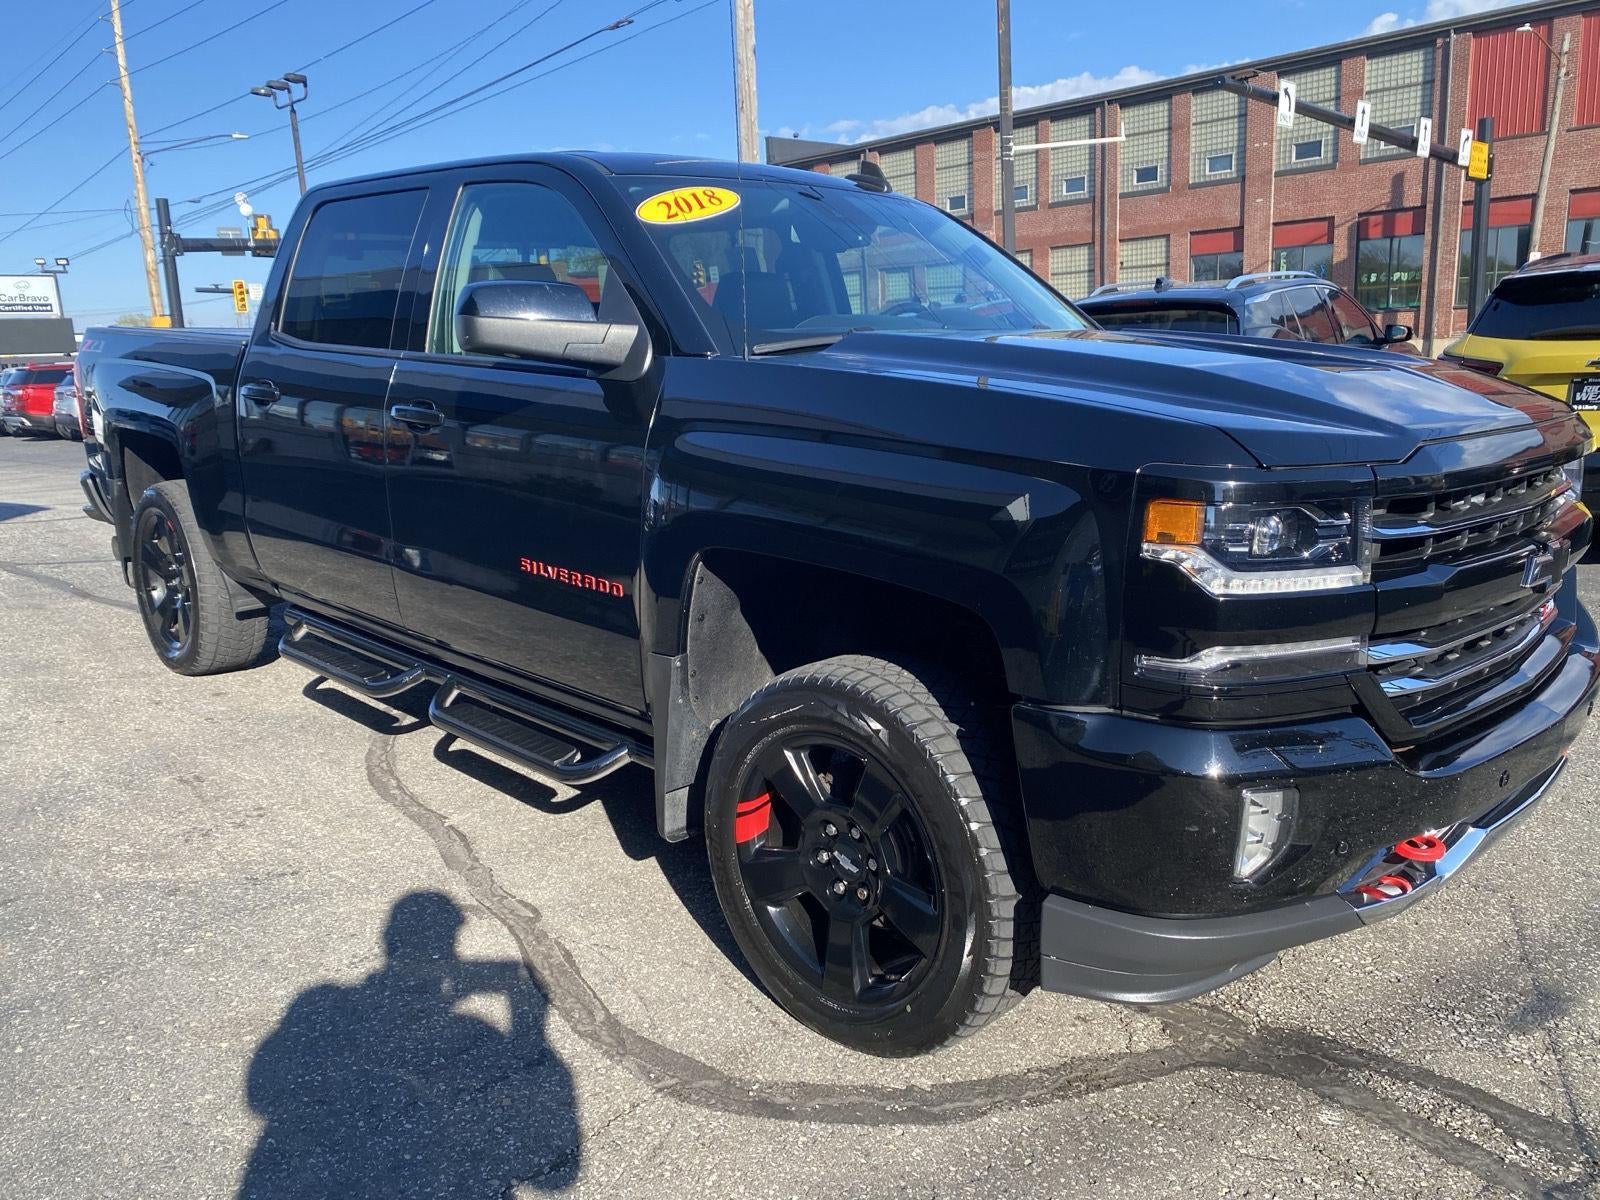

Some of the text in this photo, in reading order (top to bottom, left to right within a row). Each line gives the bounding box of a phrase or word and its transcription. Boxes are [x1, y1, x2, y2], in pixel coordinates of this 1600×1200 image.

[657, 189, 723, 219] 2018
[0, 293, 49, 302] CarBravo
[520, 557, 625, 598] SILVERADO
